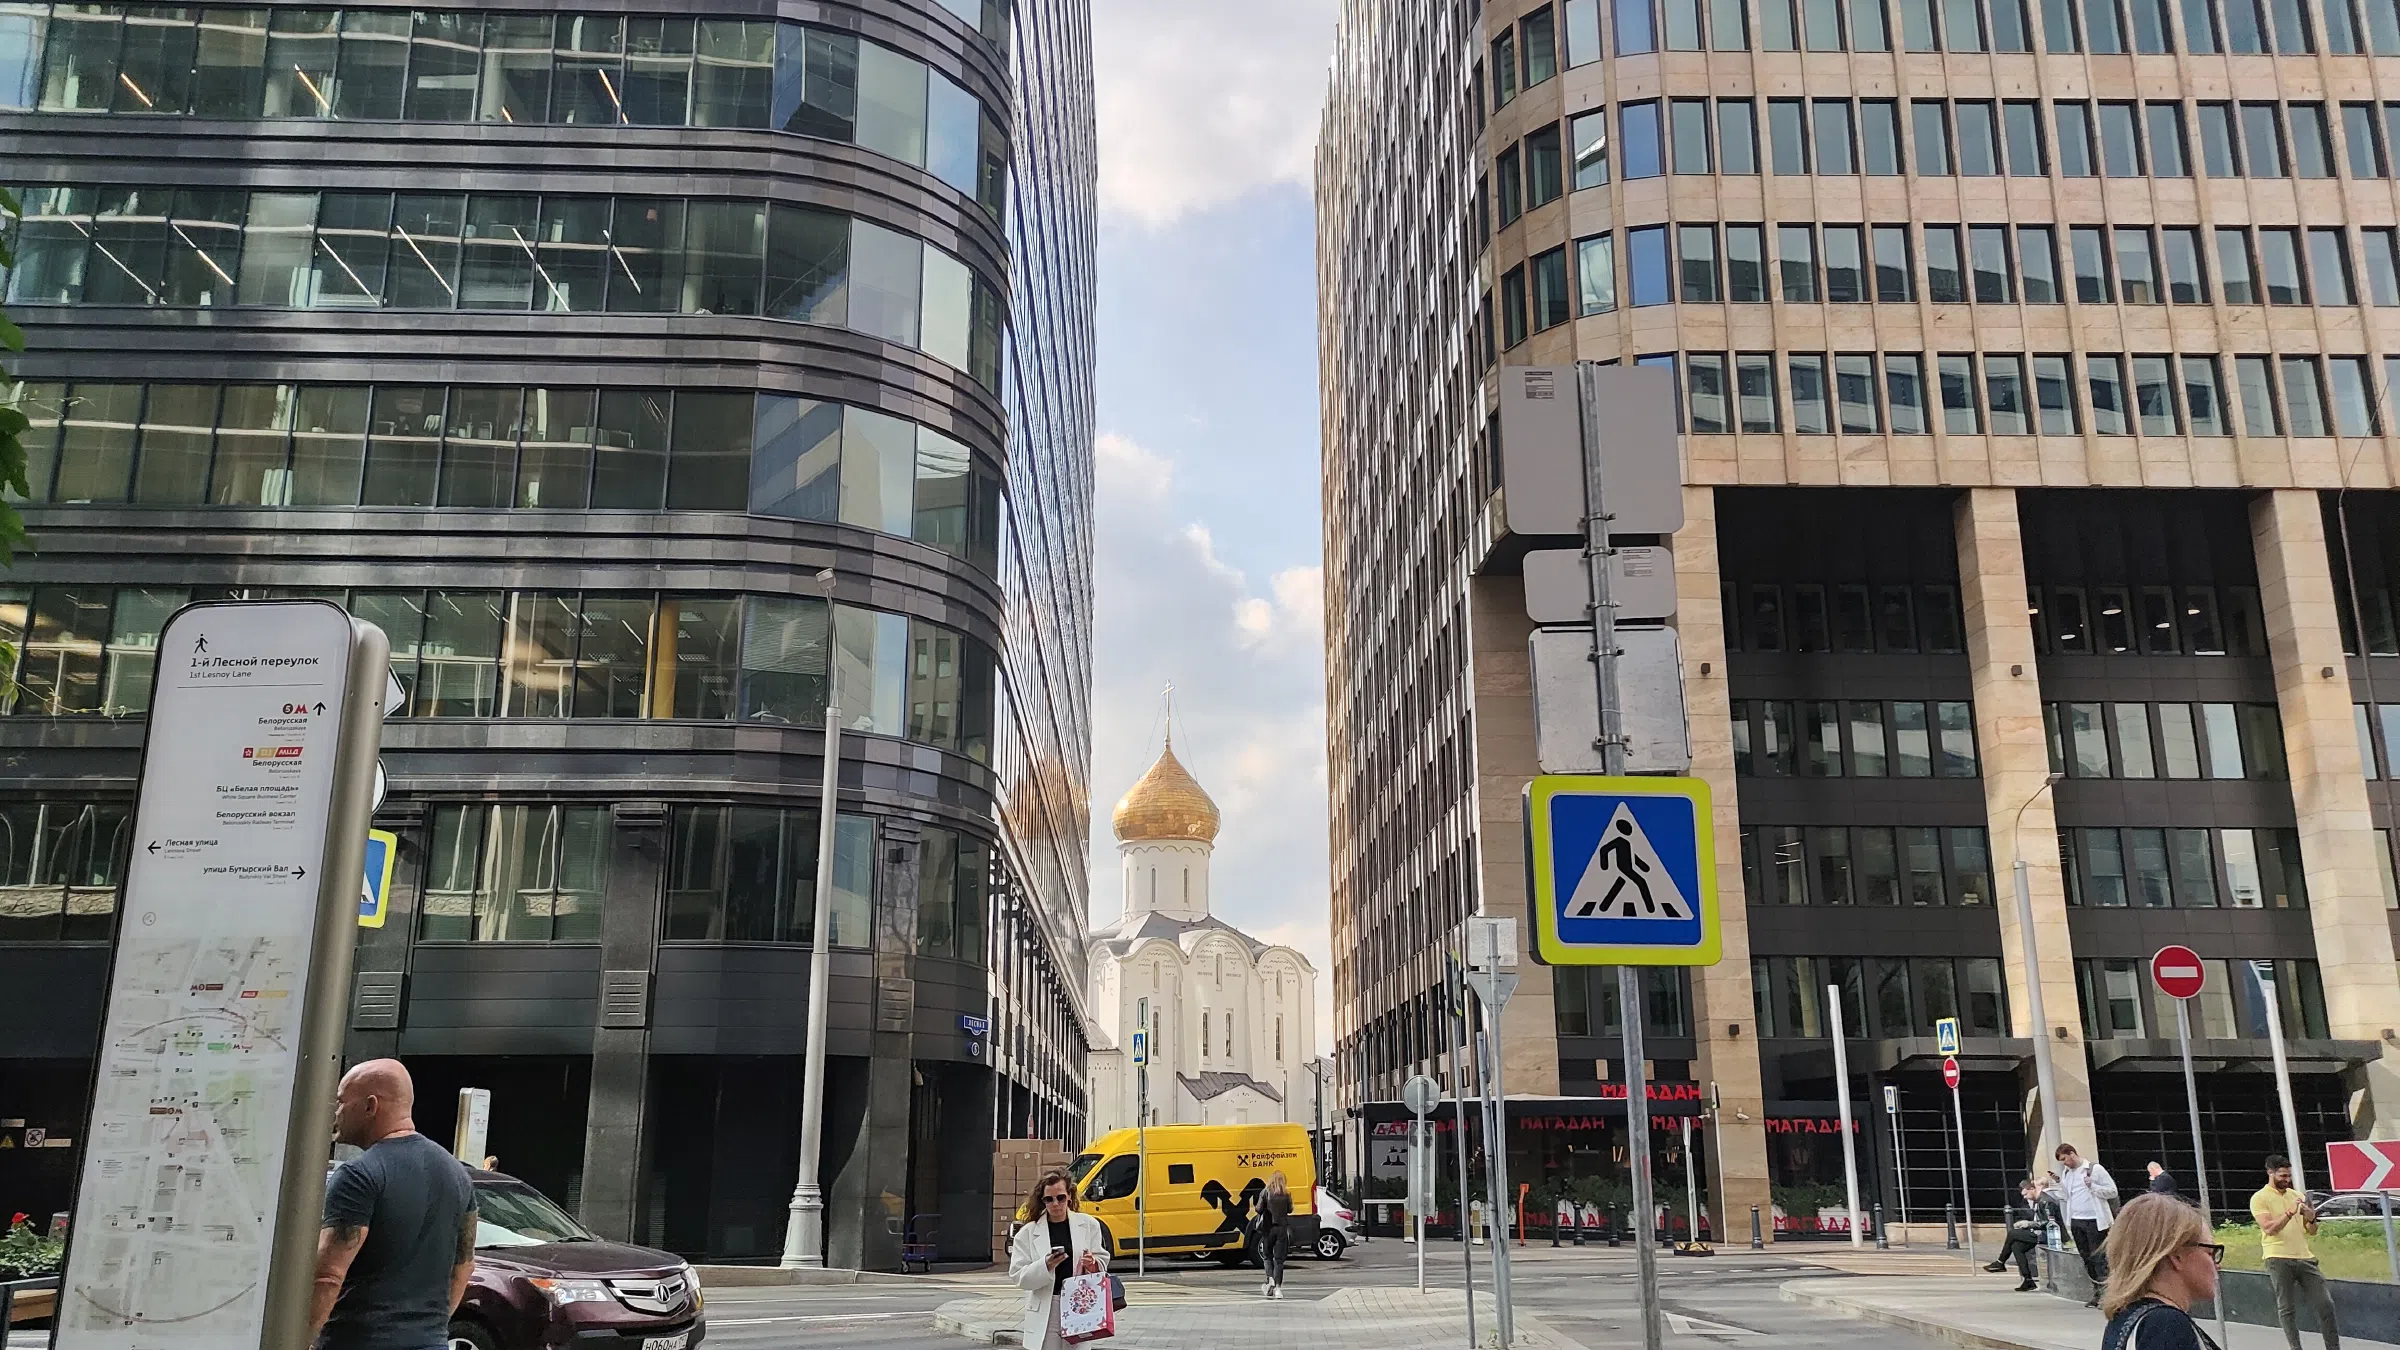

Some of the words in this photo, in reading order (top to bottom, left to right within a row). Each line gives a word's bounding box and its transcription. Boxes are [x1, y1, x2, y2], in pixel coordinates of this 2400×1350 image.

[190, 658, 210, 667] 1-й
[212, 656, 257, 666] Лесной
[260, 657, 319, 668] переулок
[202, 671, 230, 679] Lesnoy
[232, 670, 252, 678] Lane
[258, 717, 307, 725] Белорусская
[216, 811, 266, 819] Белорусский
[203, 866, 226, 874] улица
[229, 865, 272, 874] Бутырский
[1601, 1084, 1701, 1100] МААДАН
[1520, 1116, 1605, 1130] МАГАДАН
[1766, 1118, 1860, 1134] МАГАДАН
